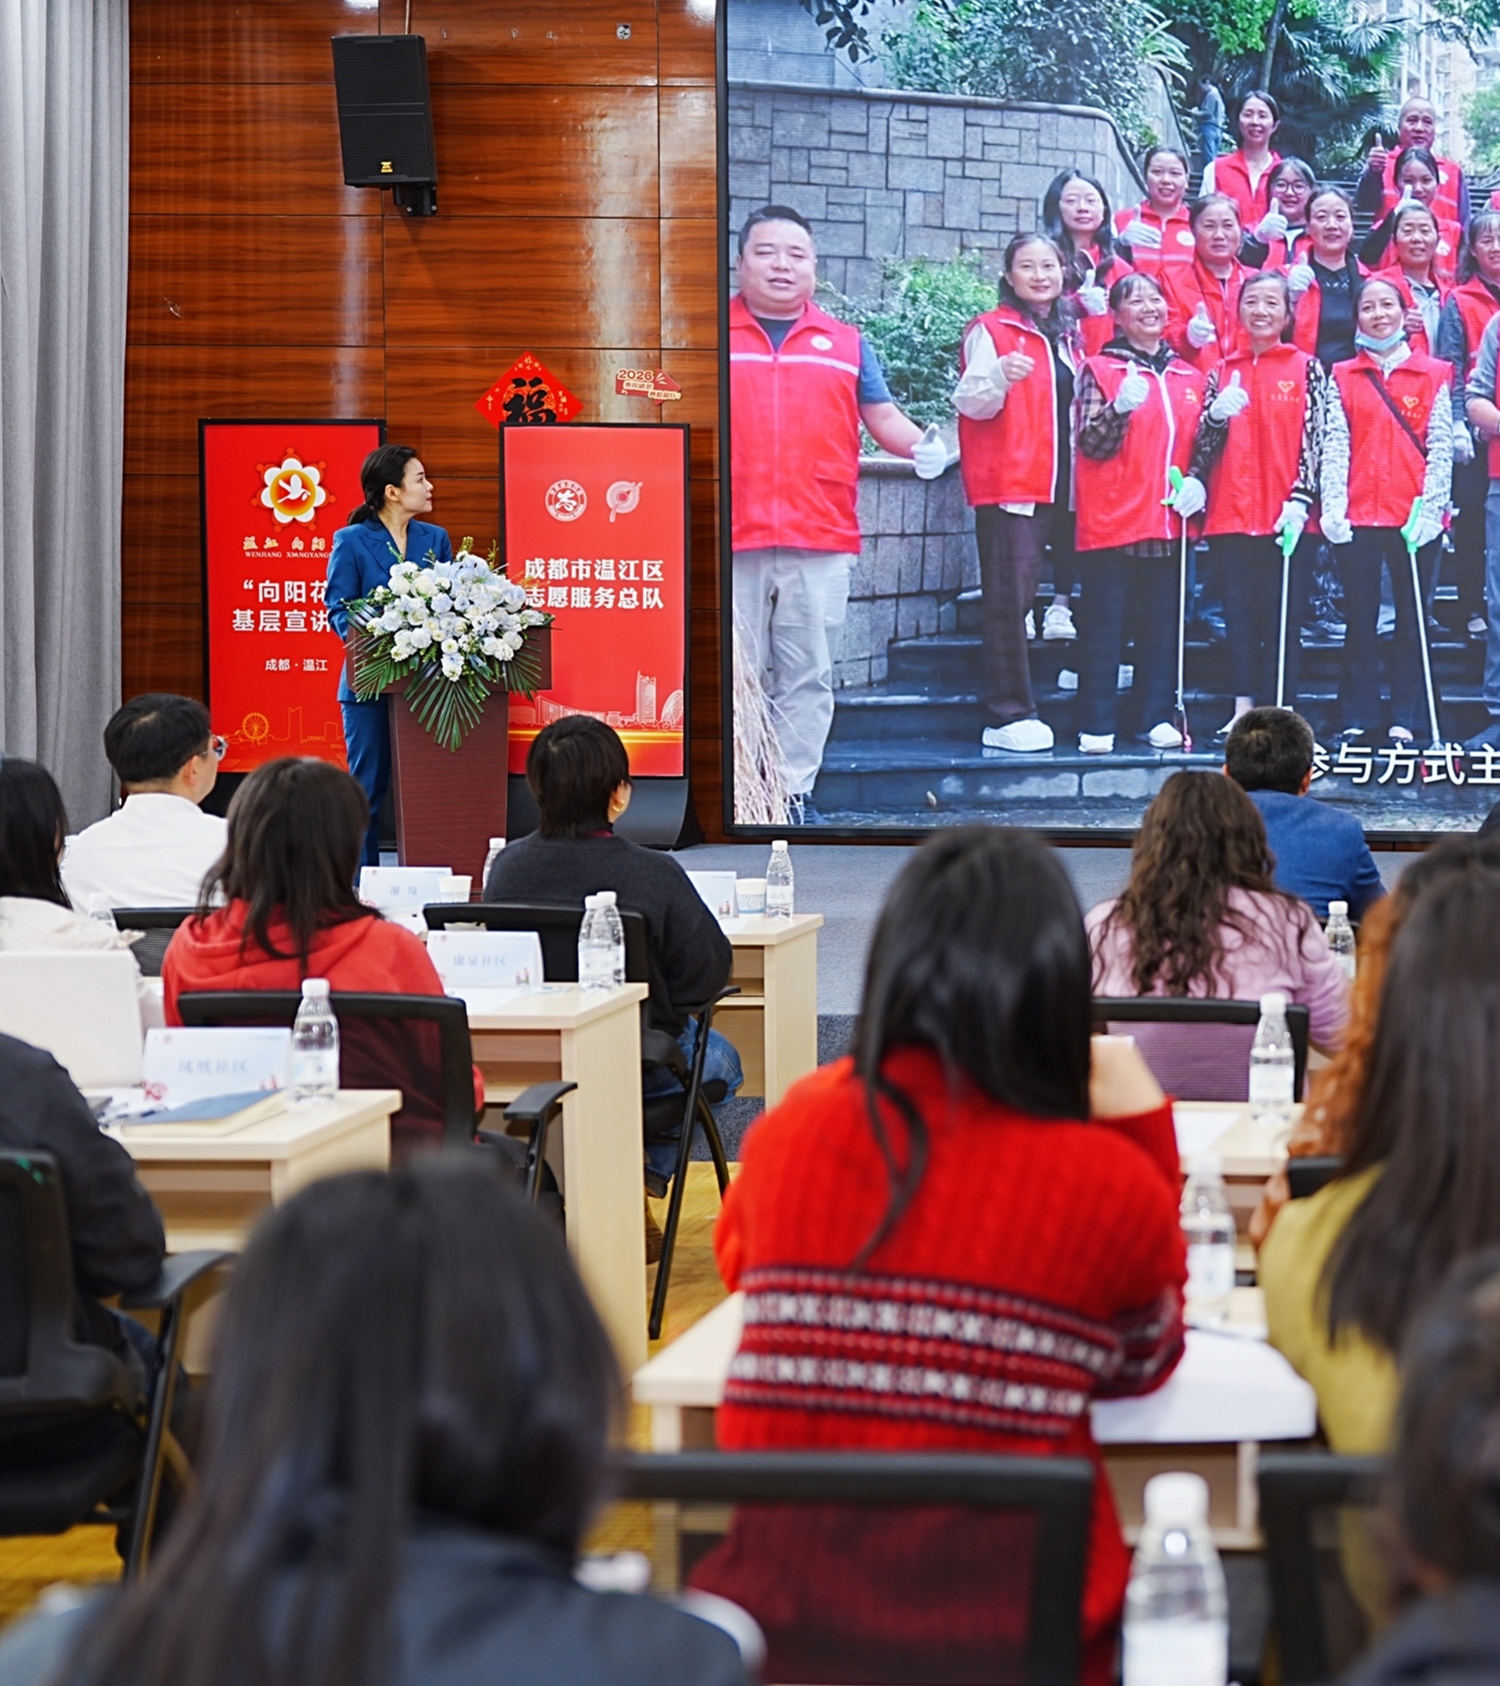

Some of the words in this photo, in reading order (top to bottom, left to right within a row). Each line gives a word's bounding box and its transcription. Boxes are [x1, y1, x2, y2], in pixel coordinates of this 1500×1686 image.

[619, 369, 653, 381] 2026
[503, 377, 557, 422] 福
[524, 558, 664, 581] 成都市温江区
[525, 586, 664, 609] 志愿服务总队
[232, 609, 331, 632] 基层宣讲
